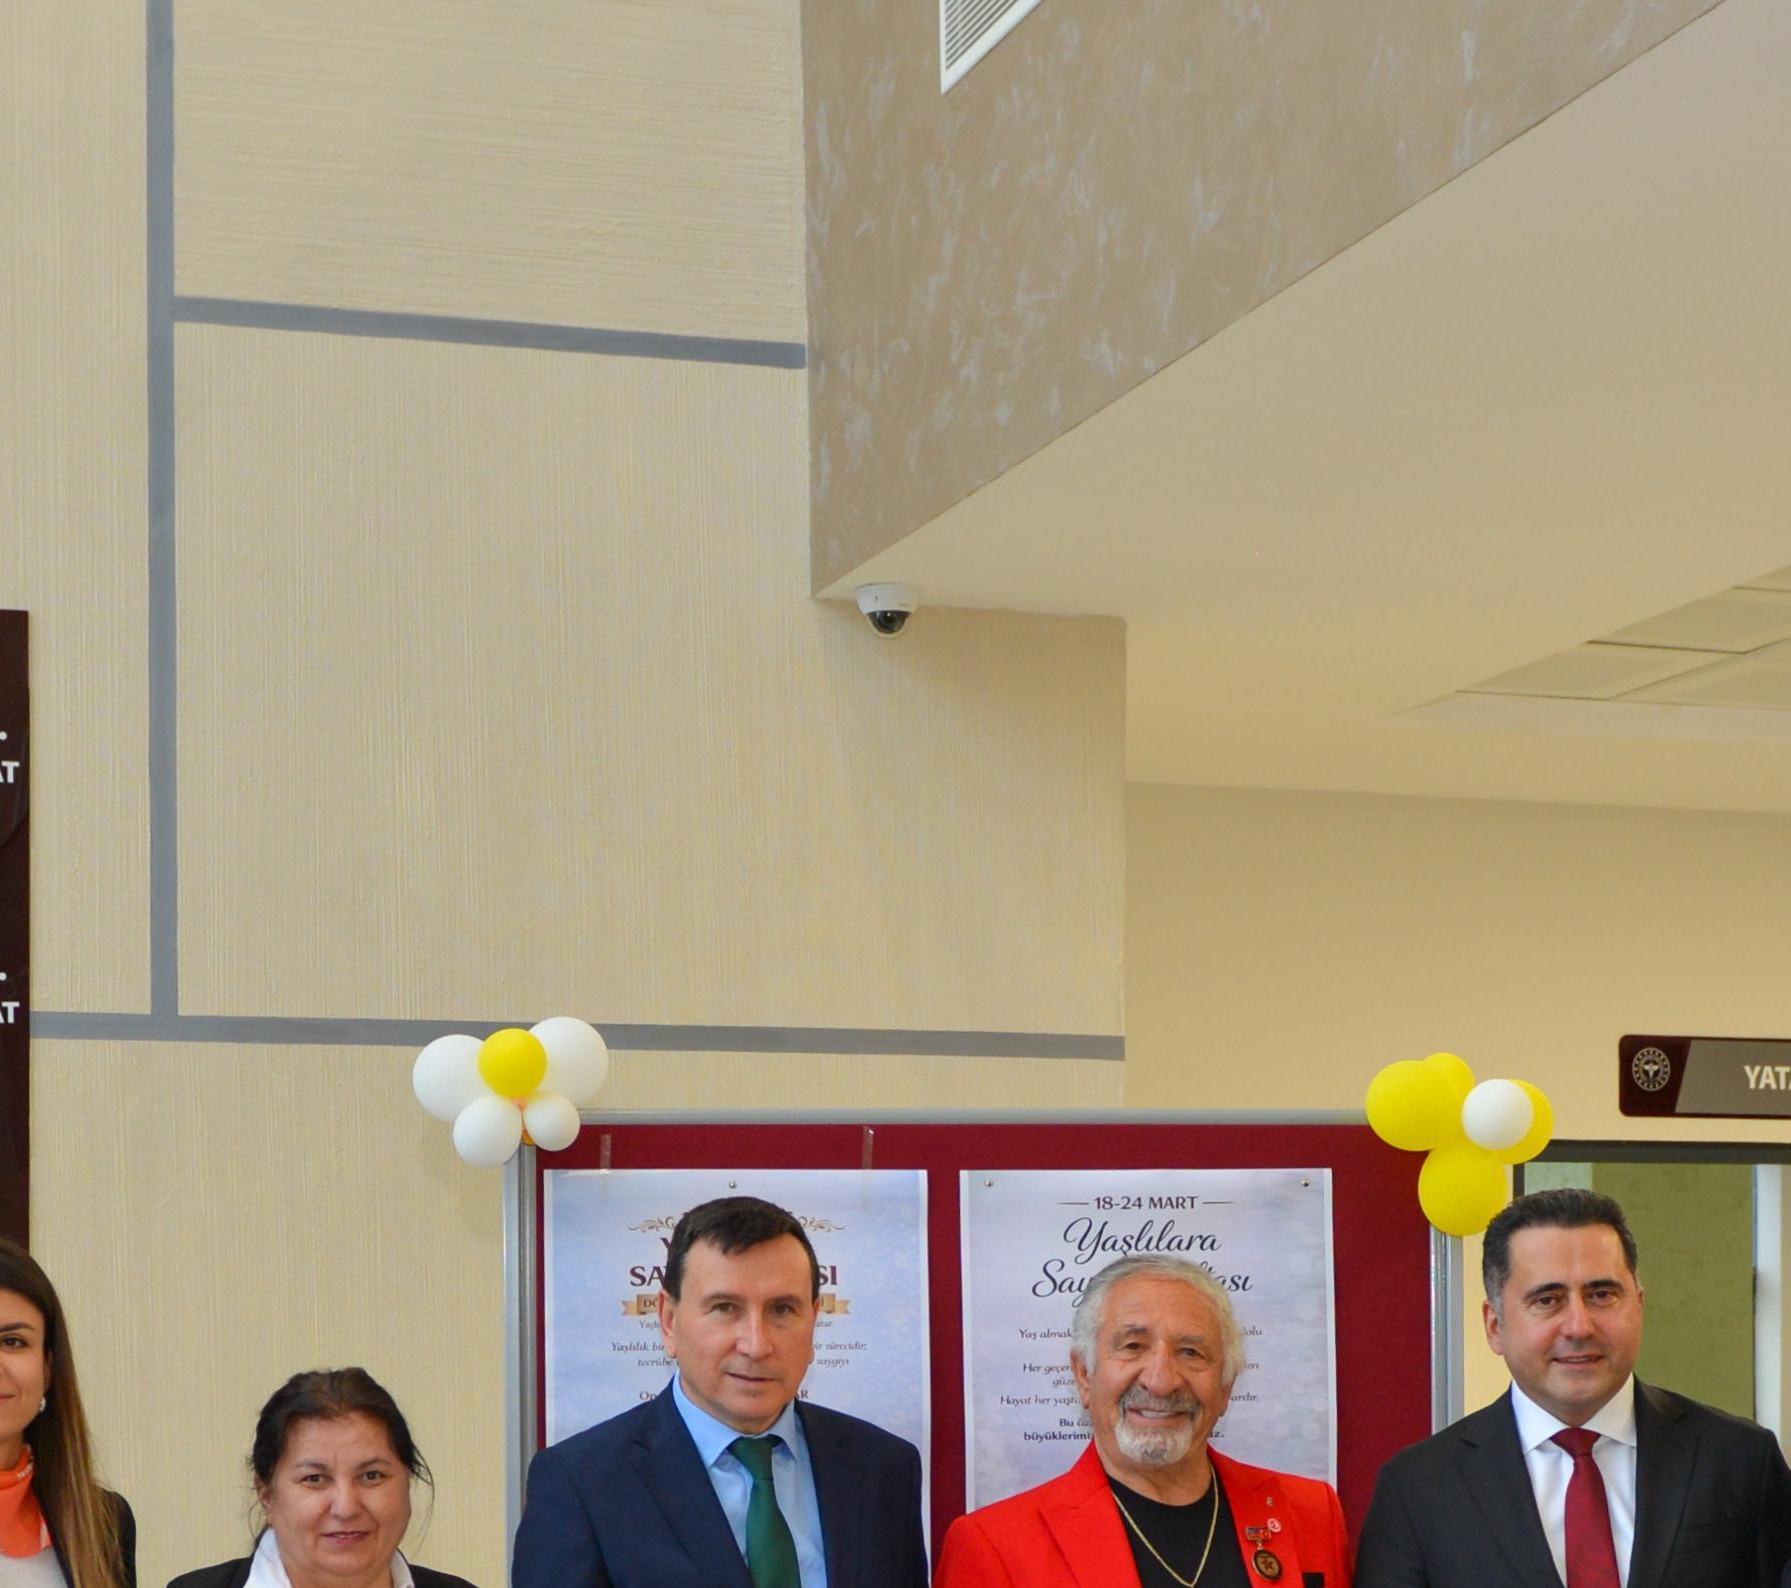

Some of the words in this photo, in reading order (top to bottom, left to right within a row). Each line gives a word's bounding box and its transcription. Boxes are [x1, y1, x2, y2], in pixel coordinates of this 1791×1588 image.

[1093, 1196, 1144, 1211] 18-24
[1148, 1195, 1199, 1210] MART
[1062, 1217, 1222, 1265] Yaşlılara
